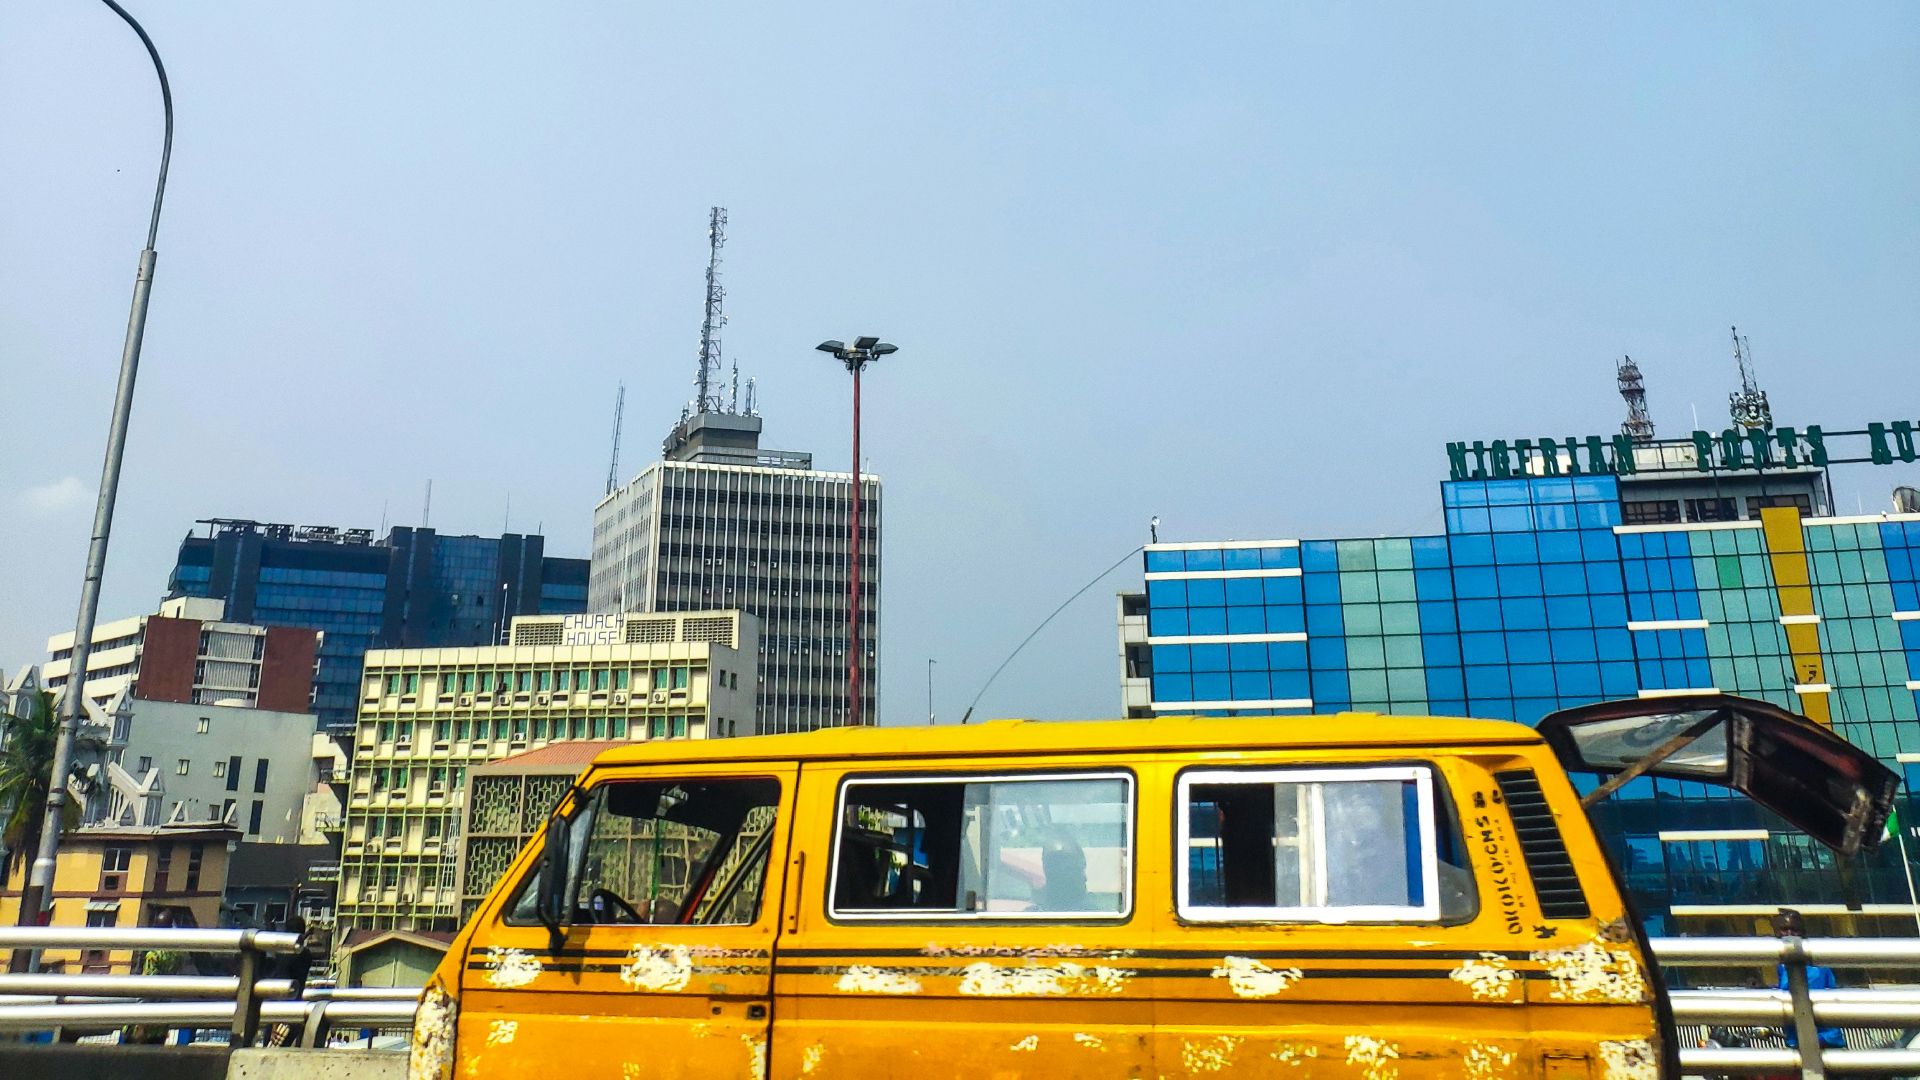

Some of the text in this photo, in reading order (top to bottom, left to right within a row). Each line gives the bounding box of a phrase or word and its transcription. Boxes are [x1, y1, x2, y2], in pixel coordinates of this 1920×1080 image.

[1446, 420, 1920, 481] NIGERIAN PORTS AU
[564, 614, 625, 629] CHURCH
